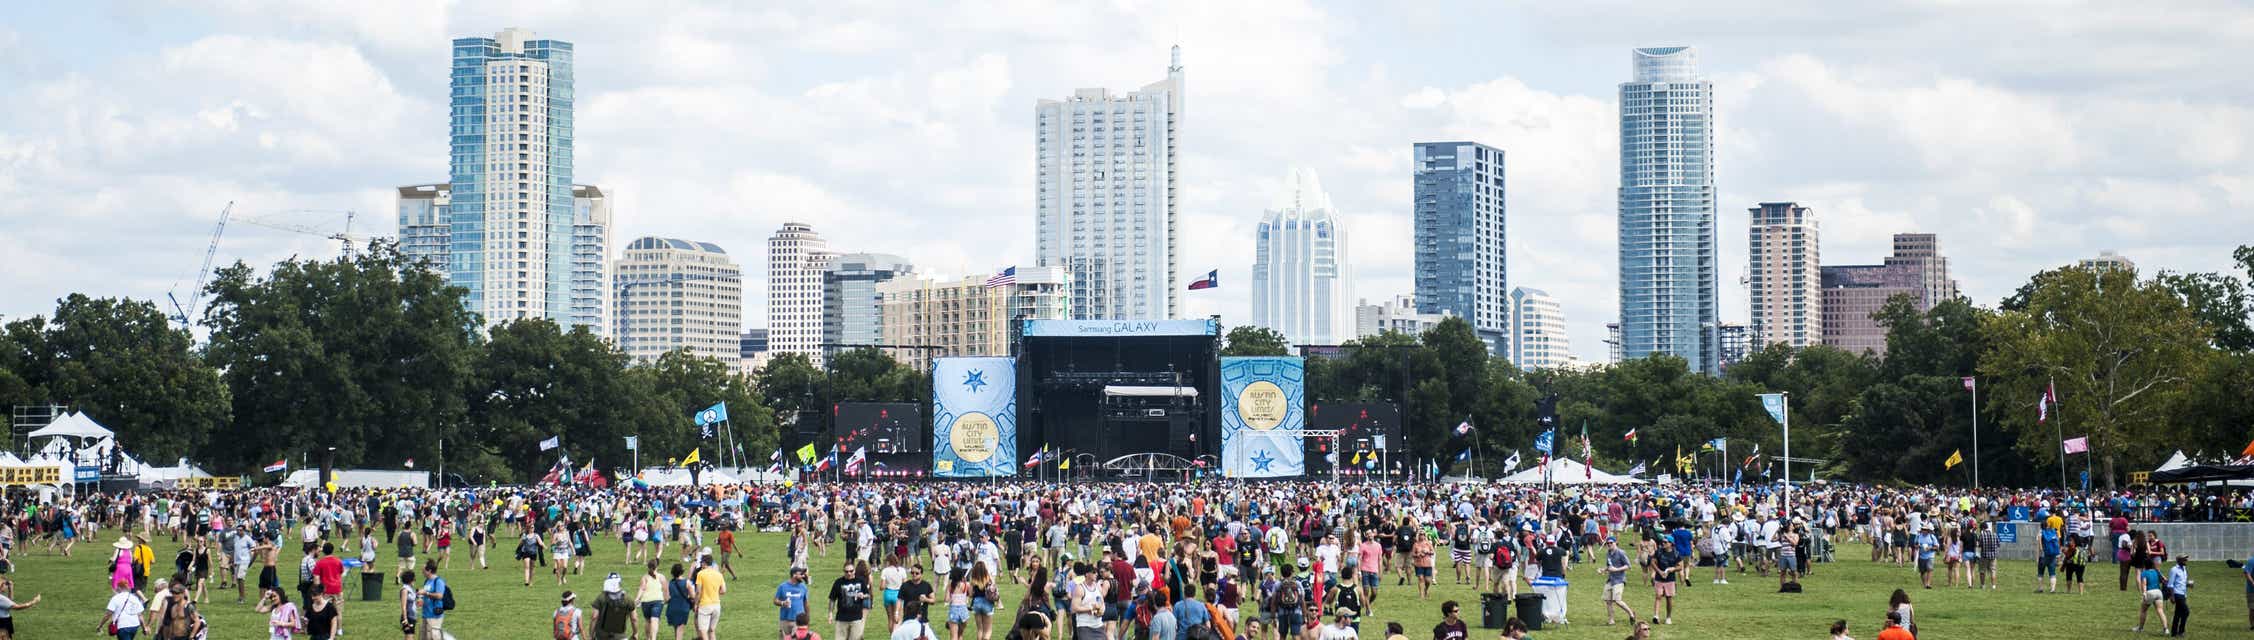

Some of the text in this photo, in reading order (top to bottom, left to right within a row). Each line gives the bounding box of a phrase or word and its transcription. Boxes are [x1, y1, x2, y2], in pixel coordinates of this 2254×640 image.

[1078, 322, 1158, 334] Samsung GALAXY
[1249, 391, 1277, 399] AUSTIN
